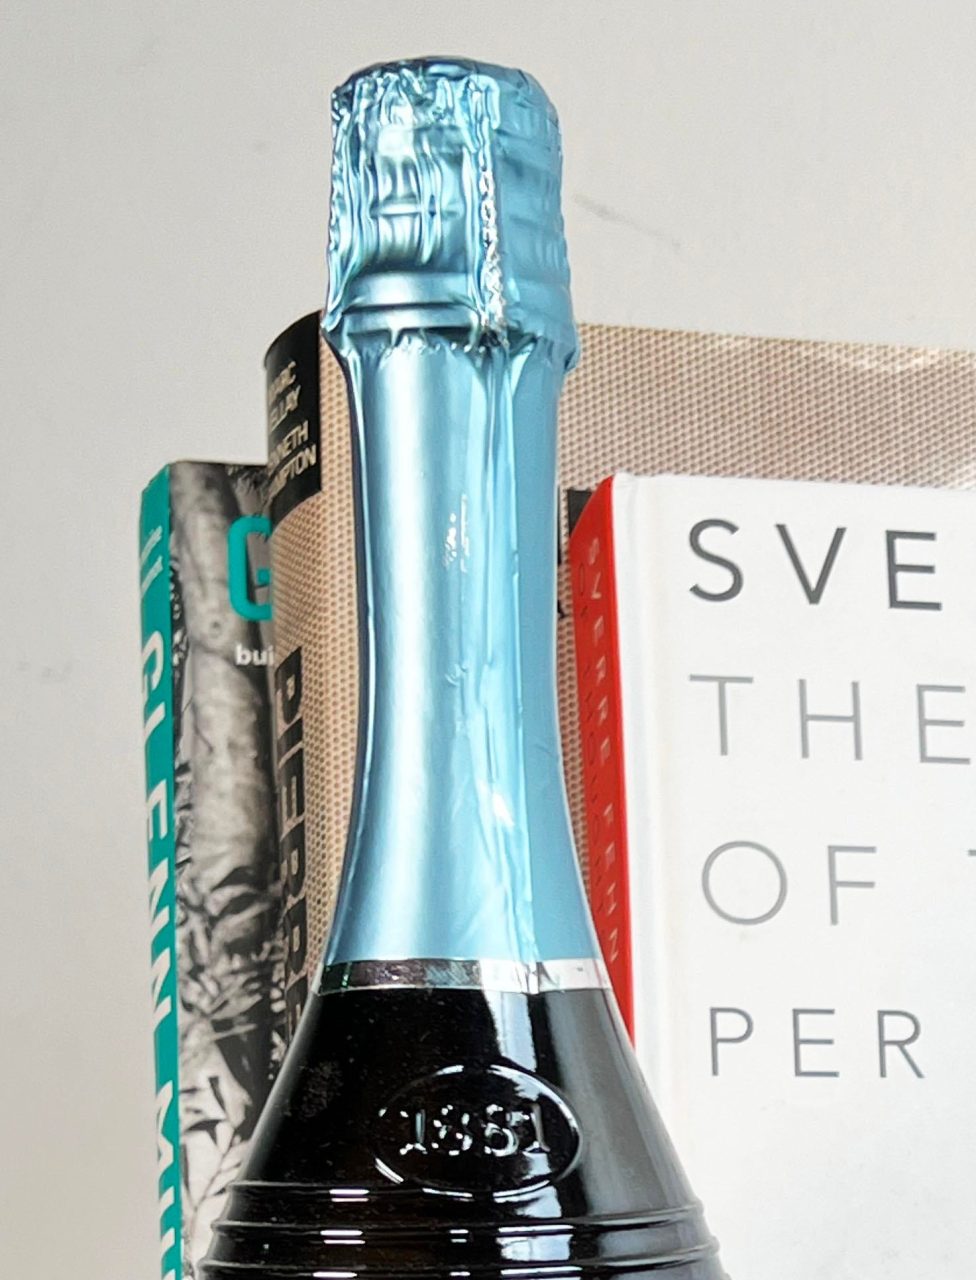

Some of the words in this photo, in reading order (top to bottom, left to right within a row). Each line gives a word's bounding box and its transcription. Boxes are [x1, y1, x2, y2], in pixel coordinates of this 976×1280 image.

[688, 673, 971, 765] THE
[700, 840, 877, 926] OF
[709, 1006, 925, 1079] PER
